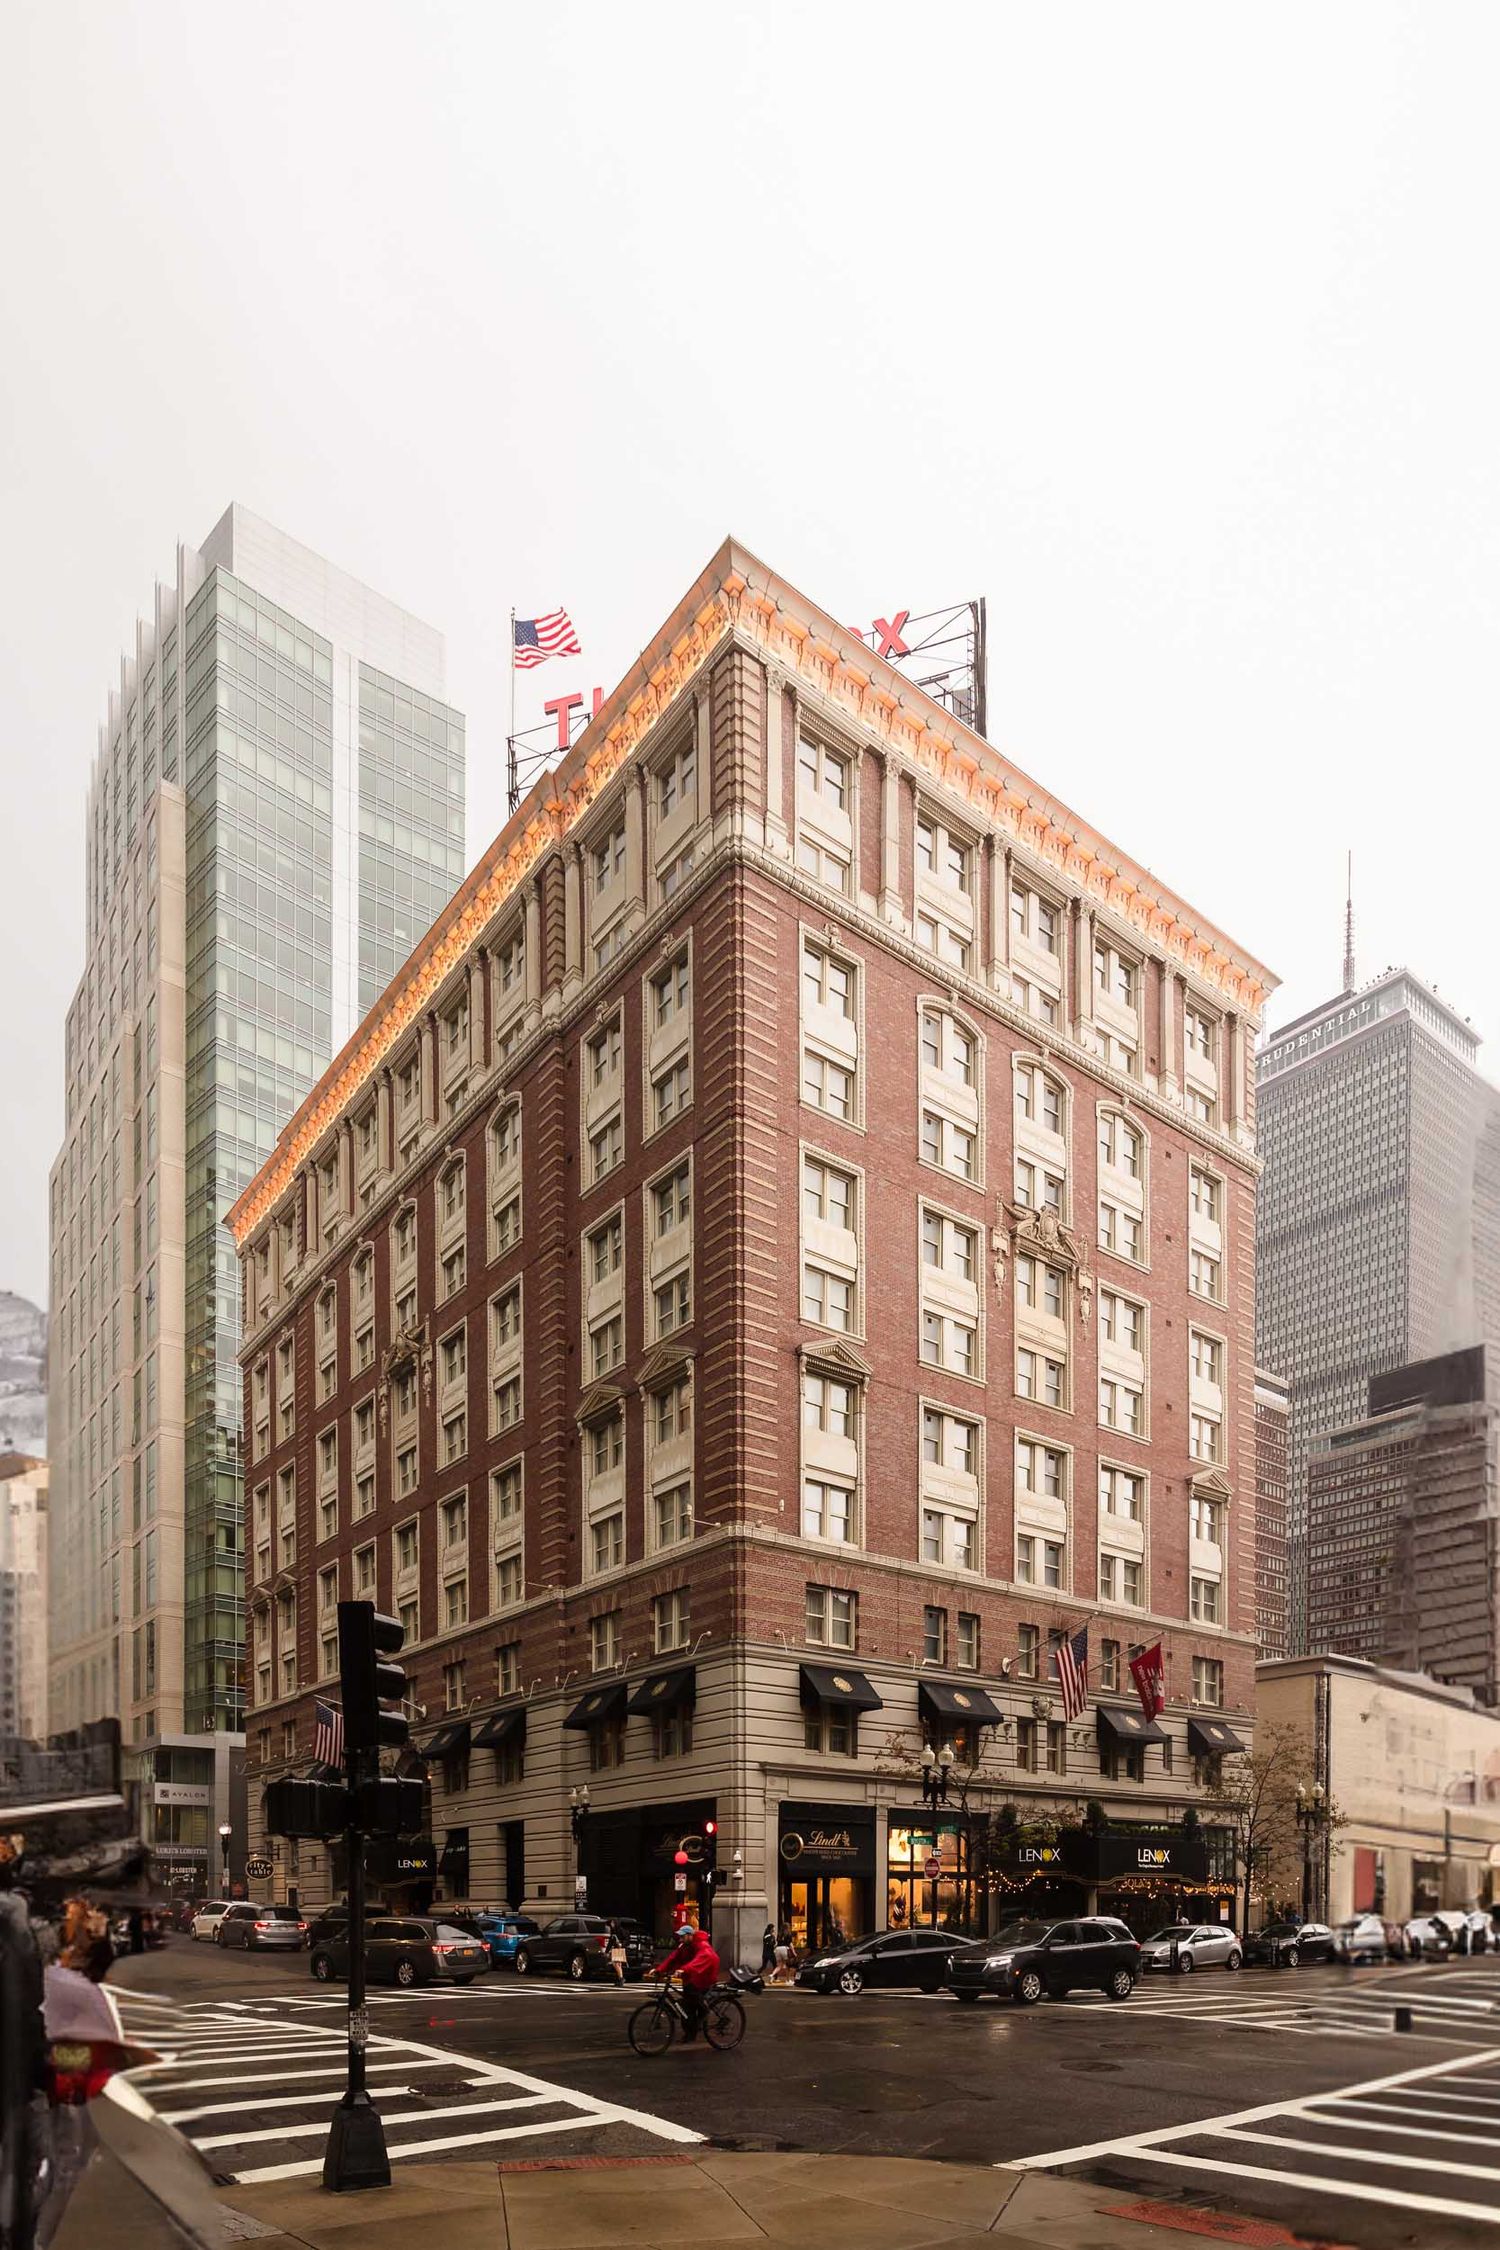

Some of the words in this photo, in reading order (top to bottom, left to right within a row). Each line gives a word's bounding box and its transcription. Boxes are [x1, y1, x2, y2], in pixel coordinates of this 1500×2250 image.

[172, 1791, 206, 1799] AVALON
[808, 1830, 842, 1846] Lindt
[1018, 1848, 1062, 1863] LENOX
[1137, 1848, 1171, 1863] LENOX
[397, 1859, 428, 1869] LENOX
